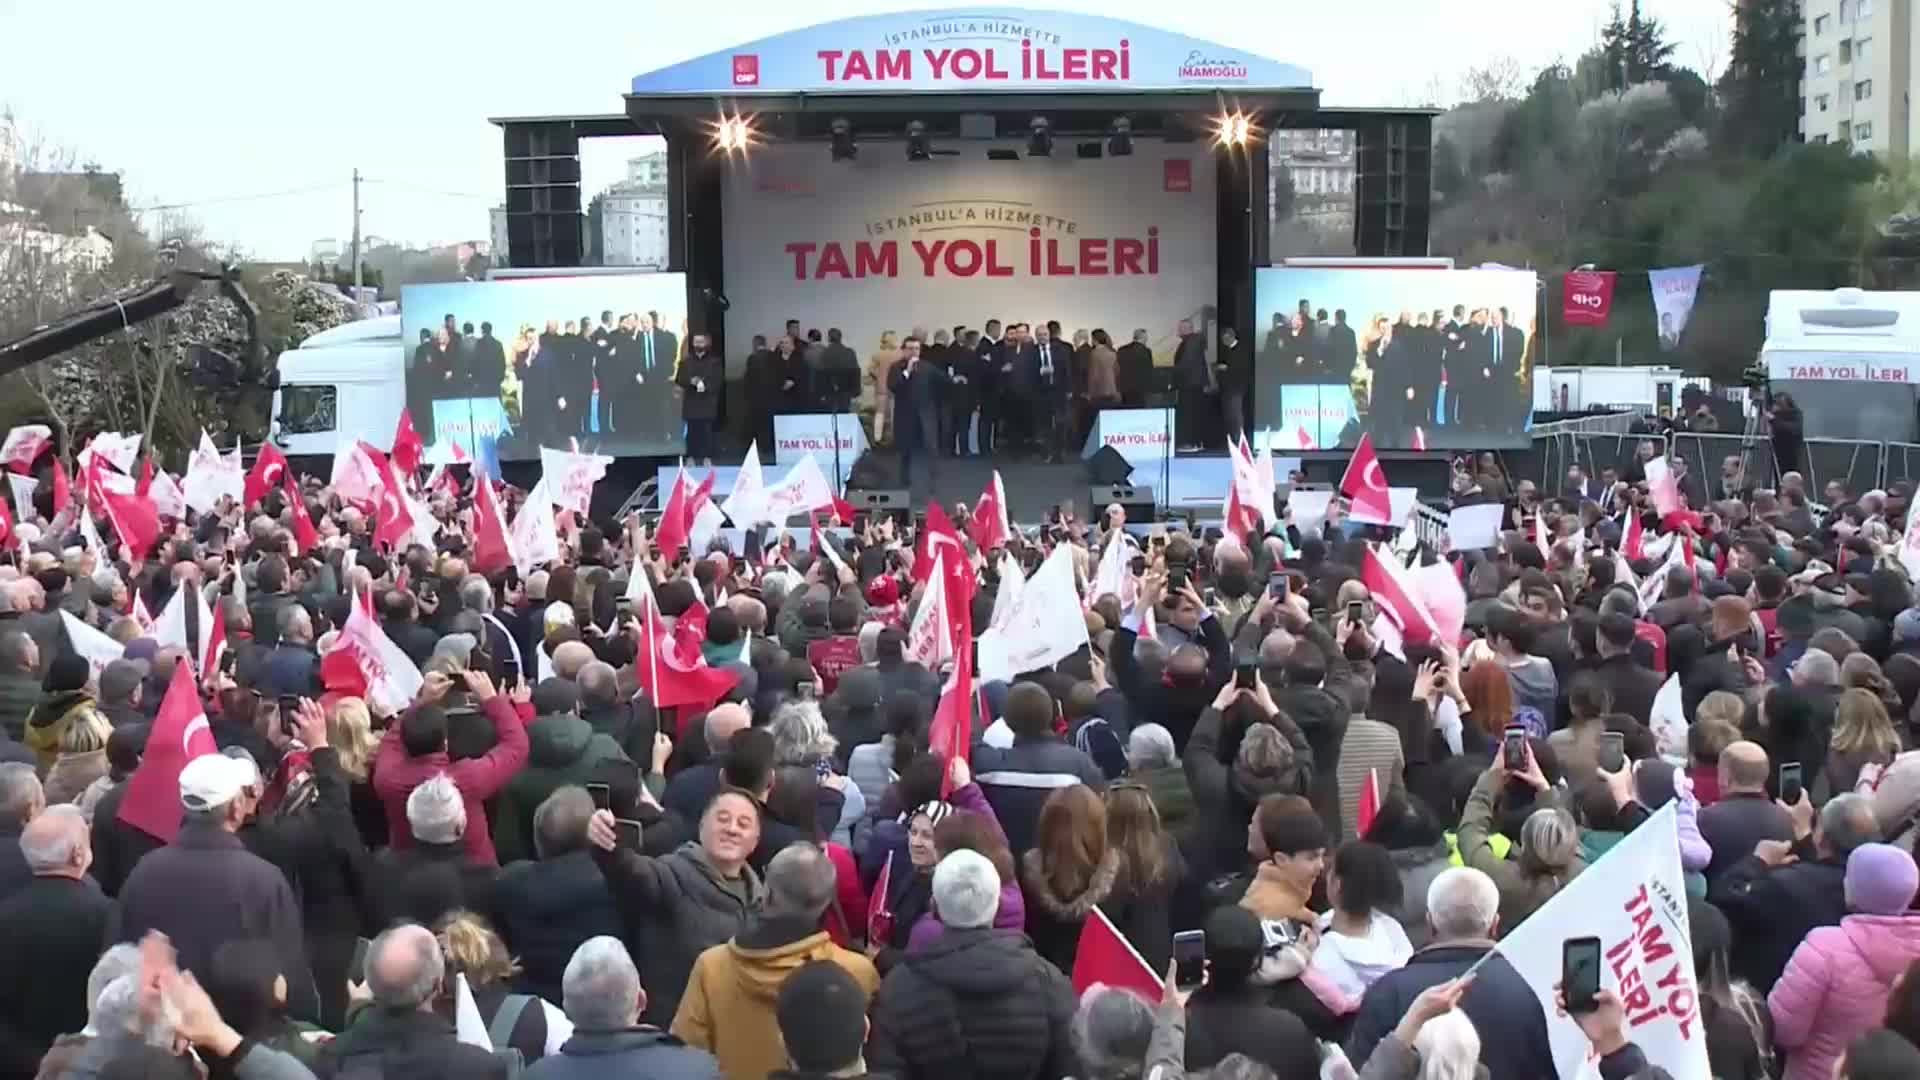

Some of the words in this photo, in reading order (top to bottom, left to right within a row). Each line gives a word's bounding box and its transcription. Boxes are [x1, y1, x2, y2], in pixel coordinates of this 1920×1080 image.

[884, 23, 976, 46] İSTANBUL'A
[984, 22, 1061, 44] HİZMETTE
[818, 50, 911, 80] TAM
[924, 48, 1008, 80] YOL
[1022, 39, 1130, 80] İLERİ
[866, 207, 976, 236] İSTANBUL'A
[985, 207, 1077, 234] HİZMETTE
[784, 240, 898, 281] TAM
[911, 239, 1014, 277] YOL
[1030, 226, 1159, 276] İLERİ
[1788, 366, 1824, 380] TAM
[1829, 367, 1860, 379] YOL
[778, 439, 800, 449] TAM
[802, 439, 822, 449] YOL
[1103, 435, 1126, 445] TAM
[1127, 434, 1147, 445] YOL
[1623, 883, 1674, 965] TAM
[1655, 961, 1697, 1041] YOL
[1605, 932, 1668, 1028] İLERİ
